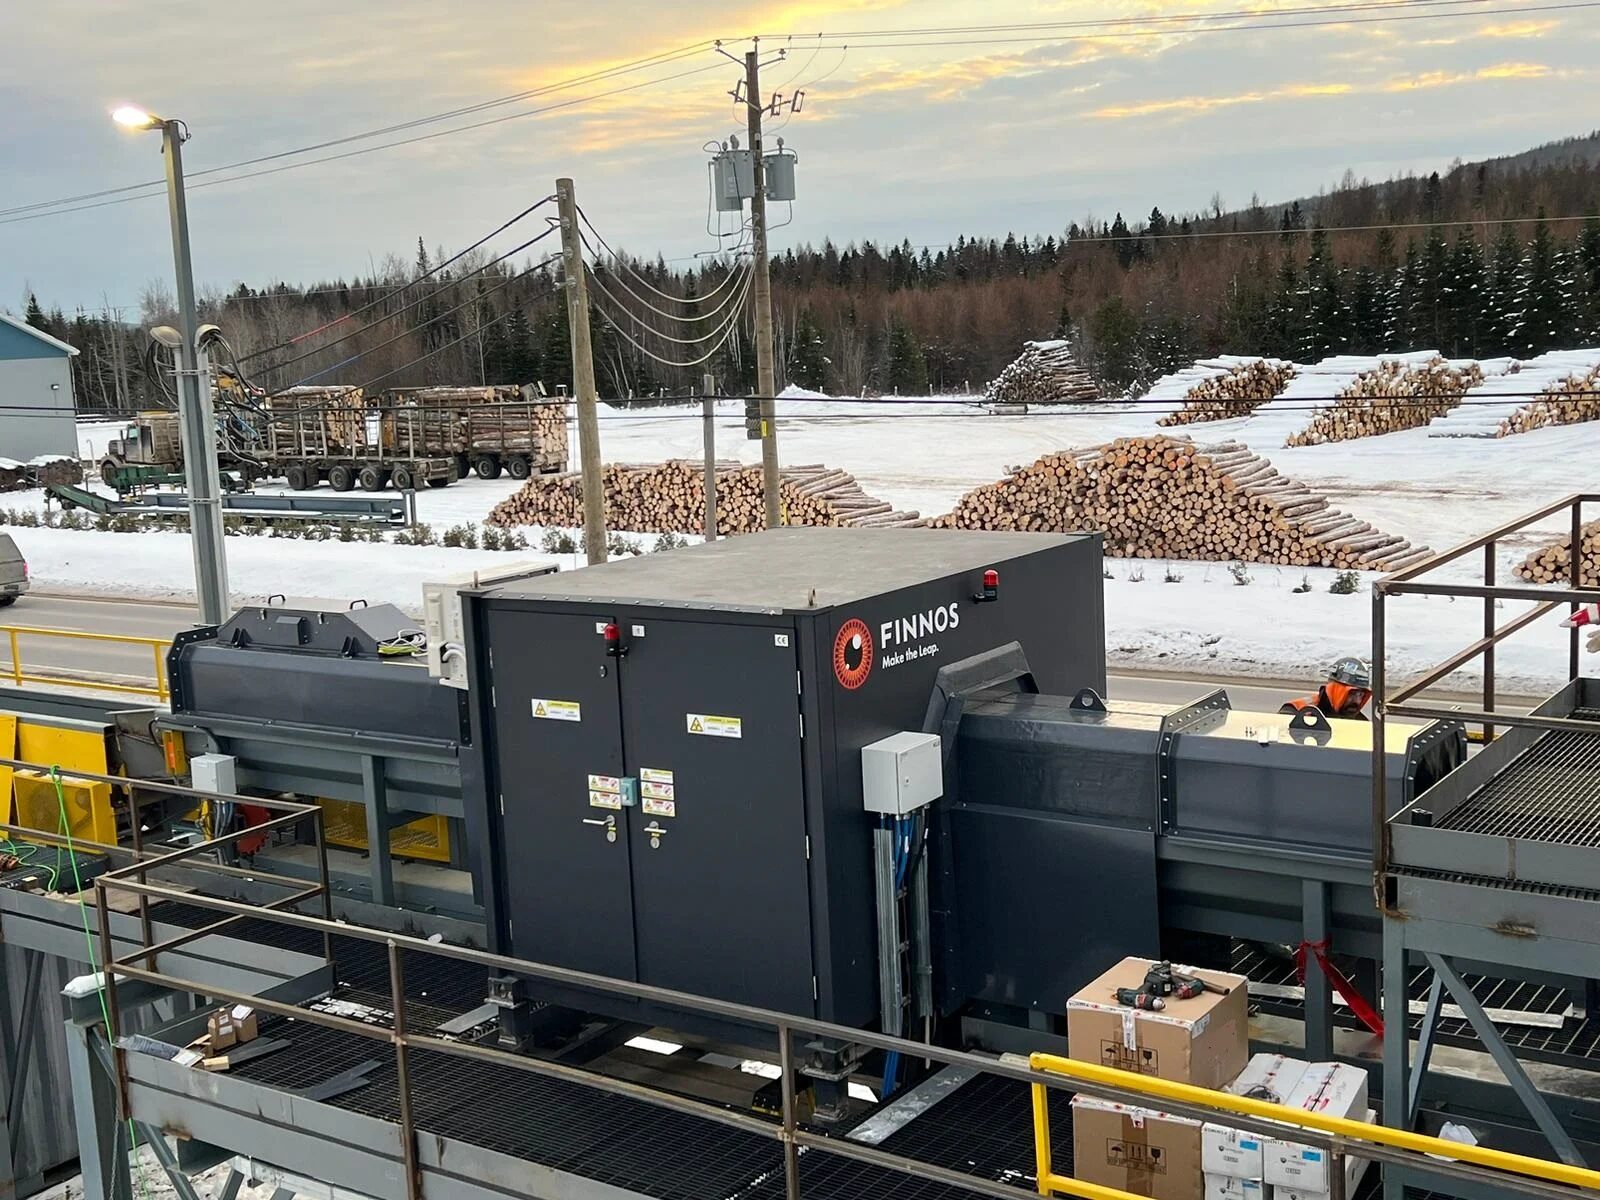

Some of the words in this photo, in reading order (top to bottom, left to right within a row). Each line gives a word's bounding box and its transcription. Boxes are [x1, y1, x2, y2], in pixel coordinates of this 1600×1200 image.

[881, 602, 959, 649] FINNOS
[777, 636, 787, 645] CE
[882, 652, 904, 669] Make
[905, 647, 918, 661] the
[919, 643, 939, 657] Leap.
